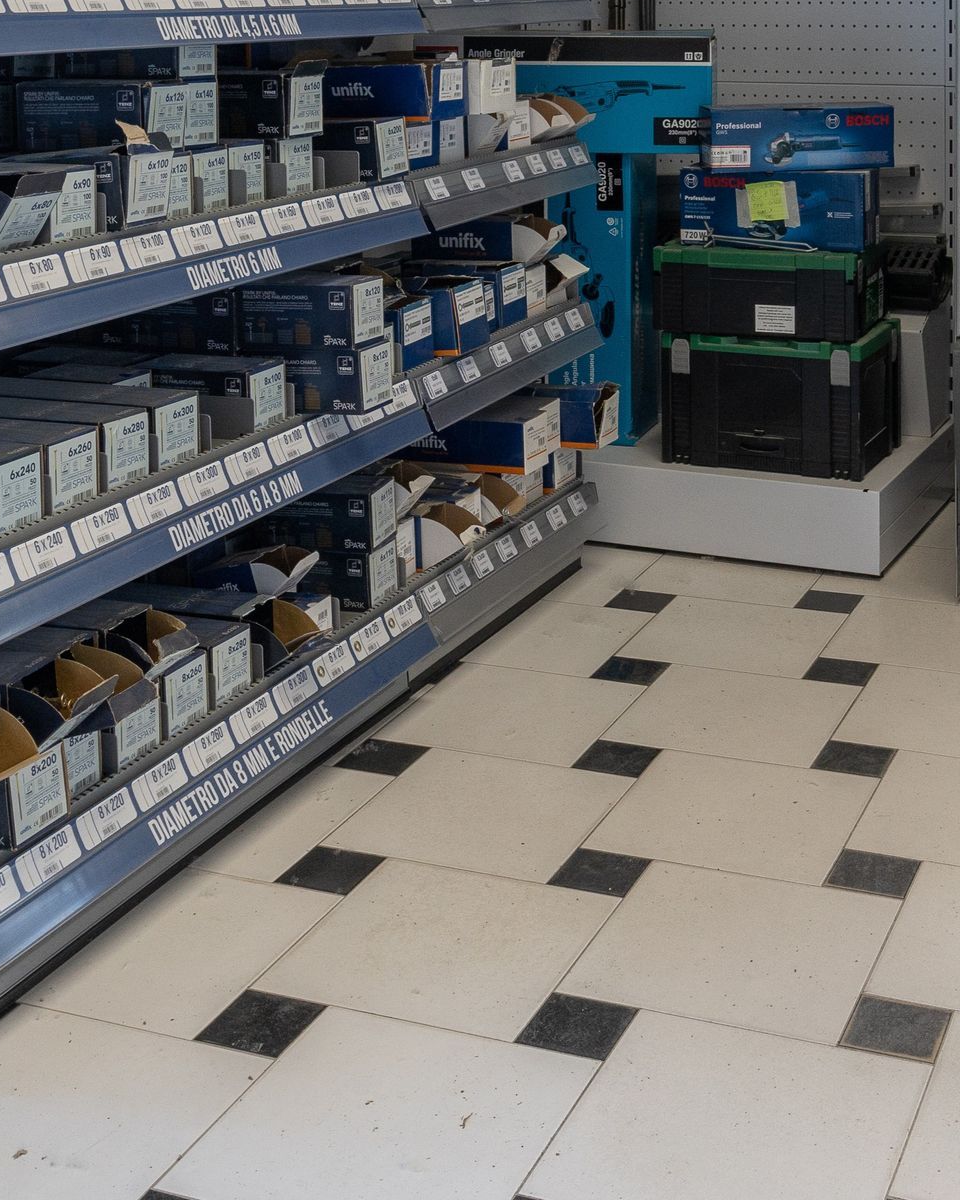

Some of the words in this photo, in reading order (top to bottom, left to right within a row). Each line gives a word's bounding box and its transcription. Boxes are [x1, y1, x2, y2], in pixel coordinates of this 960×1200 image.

[156, 15, 224, 40] DIAMETRO
[220, 16, 242, 38] DA
[240, 16, 261, 39] 4,5
[269, 14, 281, 36] 6
[279, 14, 303, 36] MM
[494, 49, 525, 58] Grinder
[331, 83, 374, 98] unifix
[716, 122, 762, 130] Professional
[846, 114, 890, 127] BOSCH
[440, 234, 485, 250] unifix
[186, 258, 248, 290] DIAMETRO
[259, 246, 282, 272] MM
[264, 372, 281, 387] 8x100
[173, 405, 194, 418] 6x300
[123, 422, 145, 435] 6x280
[68, 441, 92, 457] 6x260
[10, 463, 36, 480] 6x240
[168, 504, 234, 552] DIAMETRO
[236, 497, 250, 519] DA
[261, 484, 272, 507] A
[280, 470, 303, 496] MM
[182, 664, 202, 682] 8x260
[31, 754, 57, 776] 8x200
[148, 783, 219, 846] DIAMETRO
[214, 769, 239, 799] DA
[233, 760, 247, 784] 8
[243, 744, 271, 778] MM
[267, 737, 279, 762] E
[273, 699, 333, 755] RONDELLE
